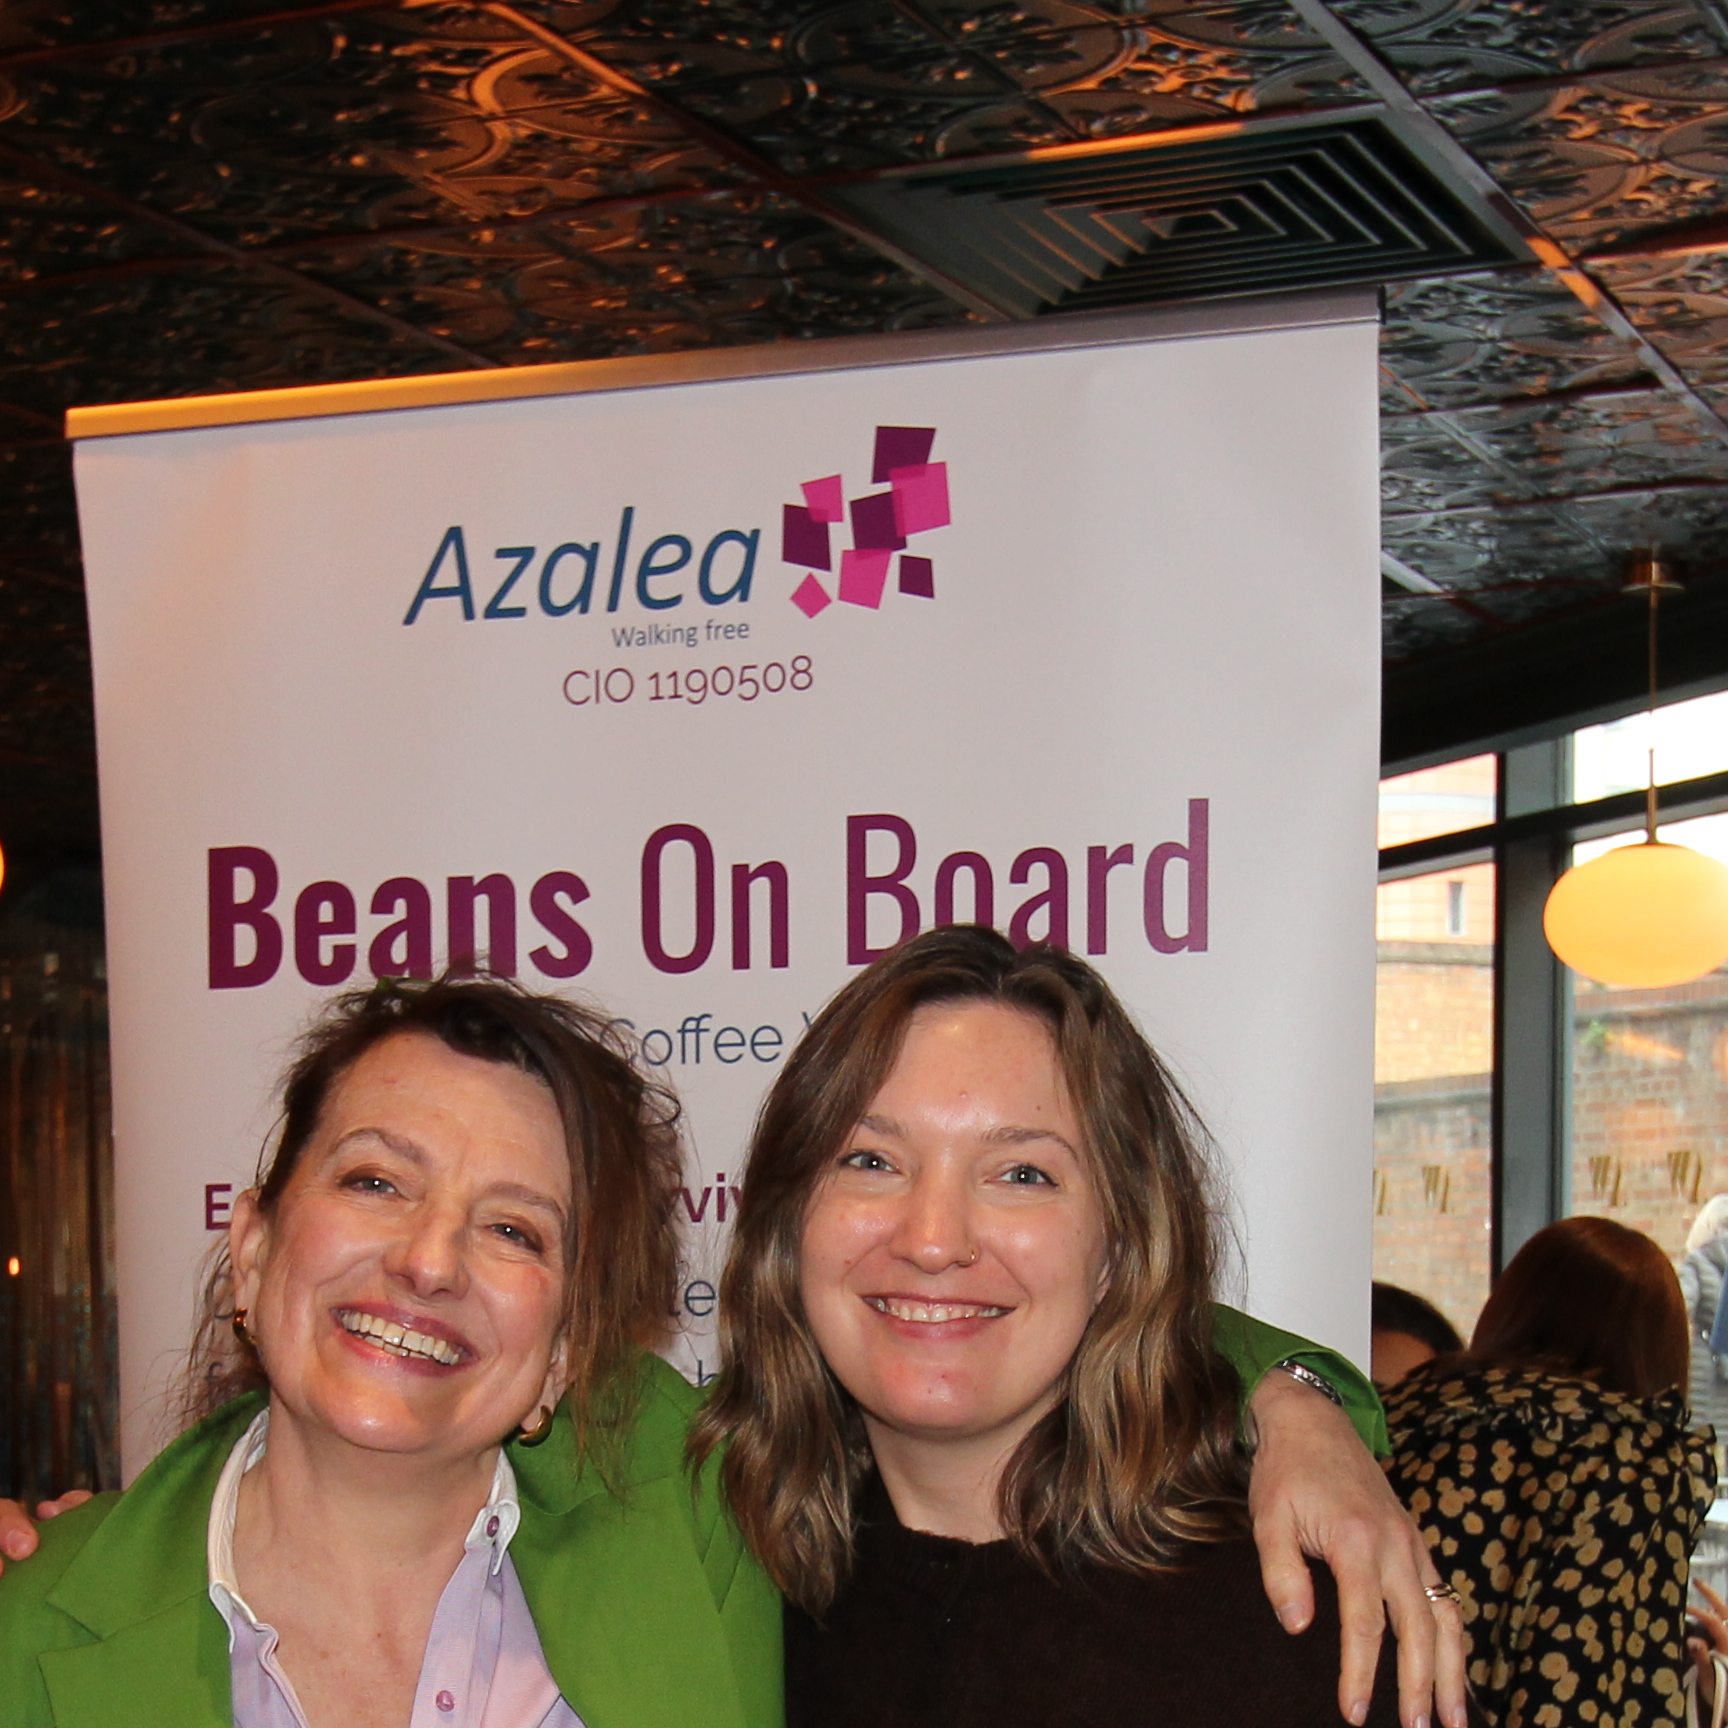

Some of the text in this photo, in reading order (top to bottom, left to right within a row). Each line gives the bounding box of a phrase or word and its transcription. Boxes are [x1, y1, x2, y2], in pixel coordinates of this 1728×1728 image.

[403, 507, 762, 626] Azalea
[611, 619, 751, 648] Walking free
[562, 654, 814, 706] CIO 1190508
[208, 798, 1210, 989] Beans On Board
